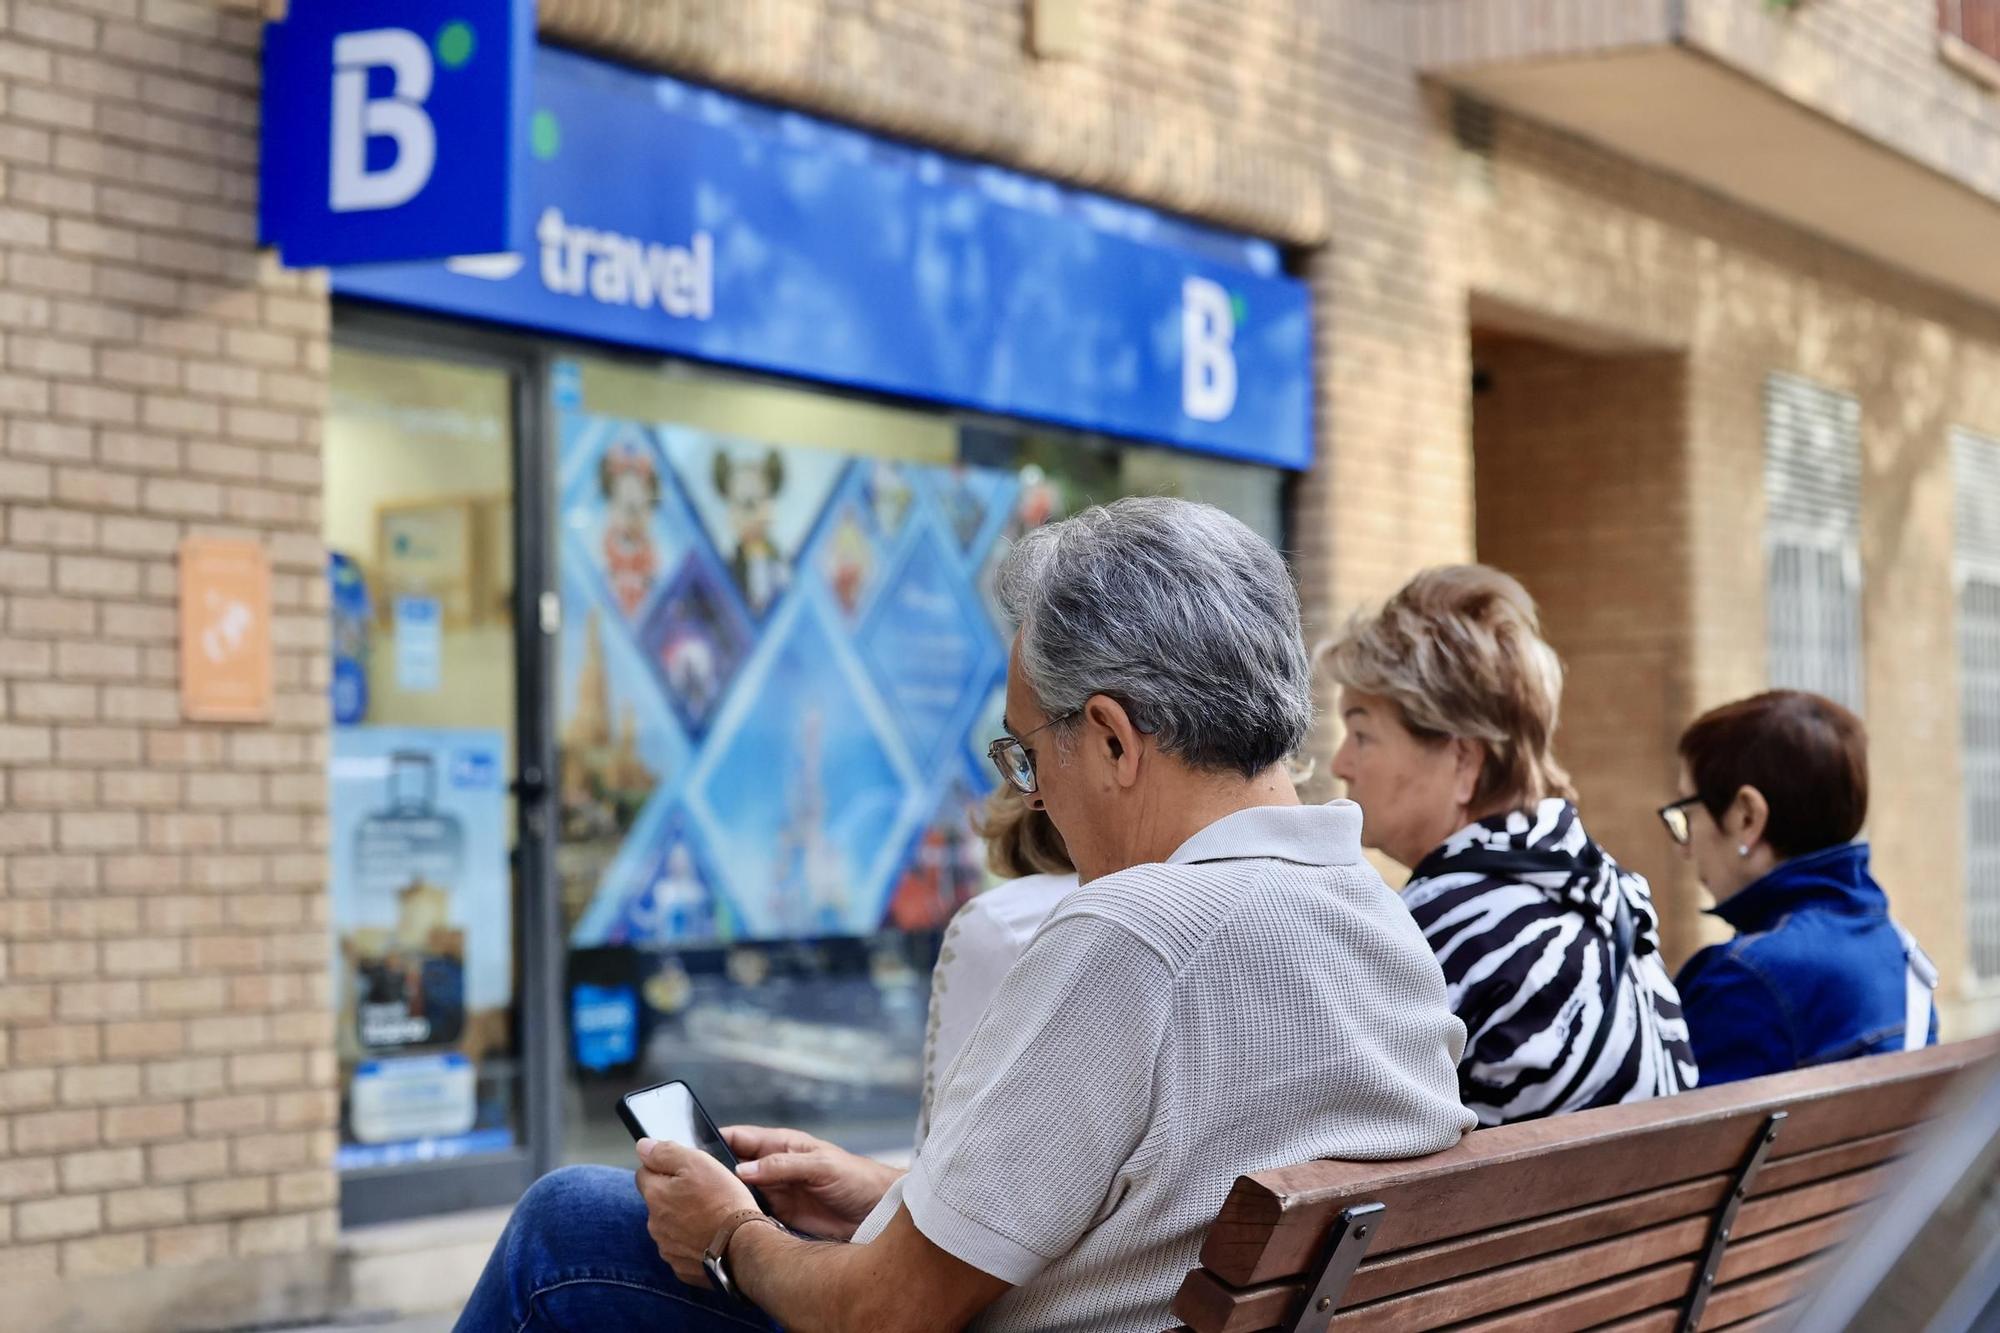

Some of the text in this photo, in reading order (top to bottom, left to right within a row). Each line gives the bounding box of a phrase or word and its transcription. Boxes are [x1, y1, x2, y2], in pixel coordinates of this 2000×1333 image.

[330, 28, 436, 211] B
[537, 206, 715, 320] travel
[1180, 276, 1238, 422] B
